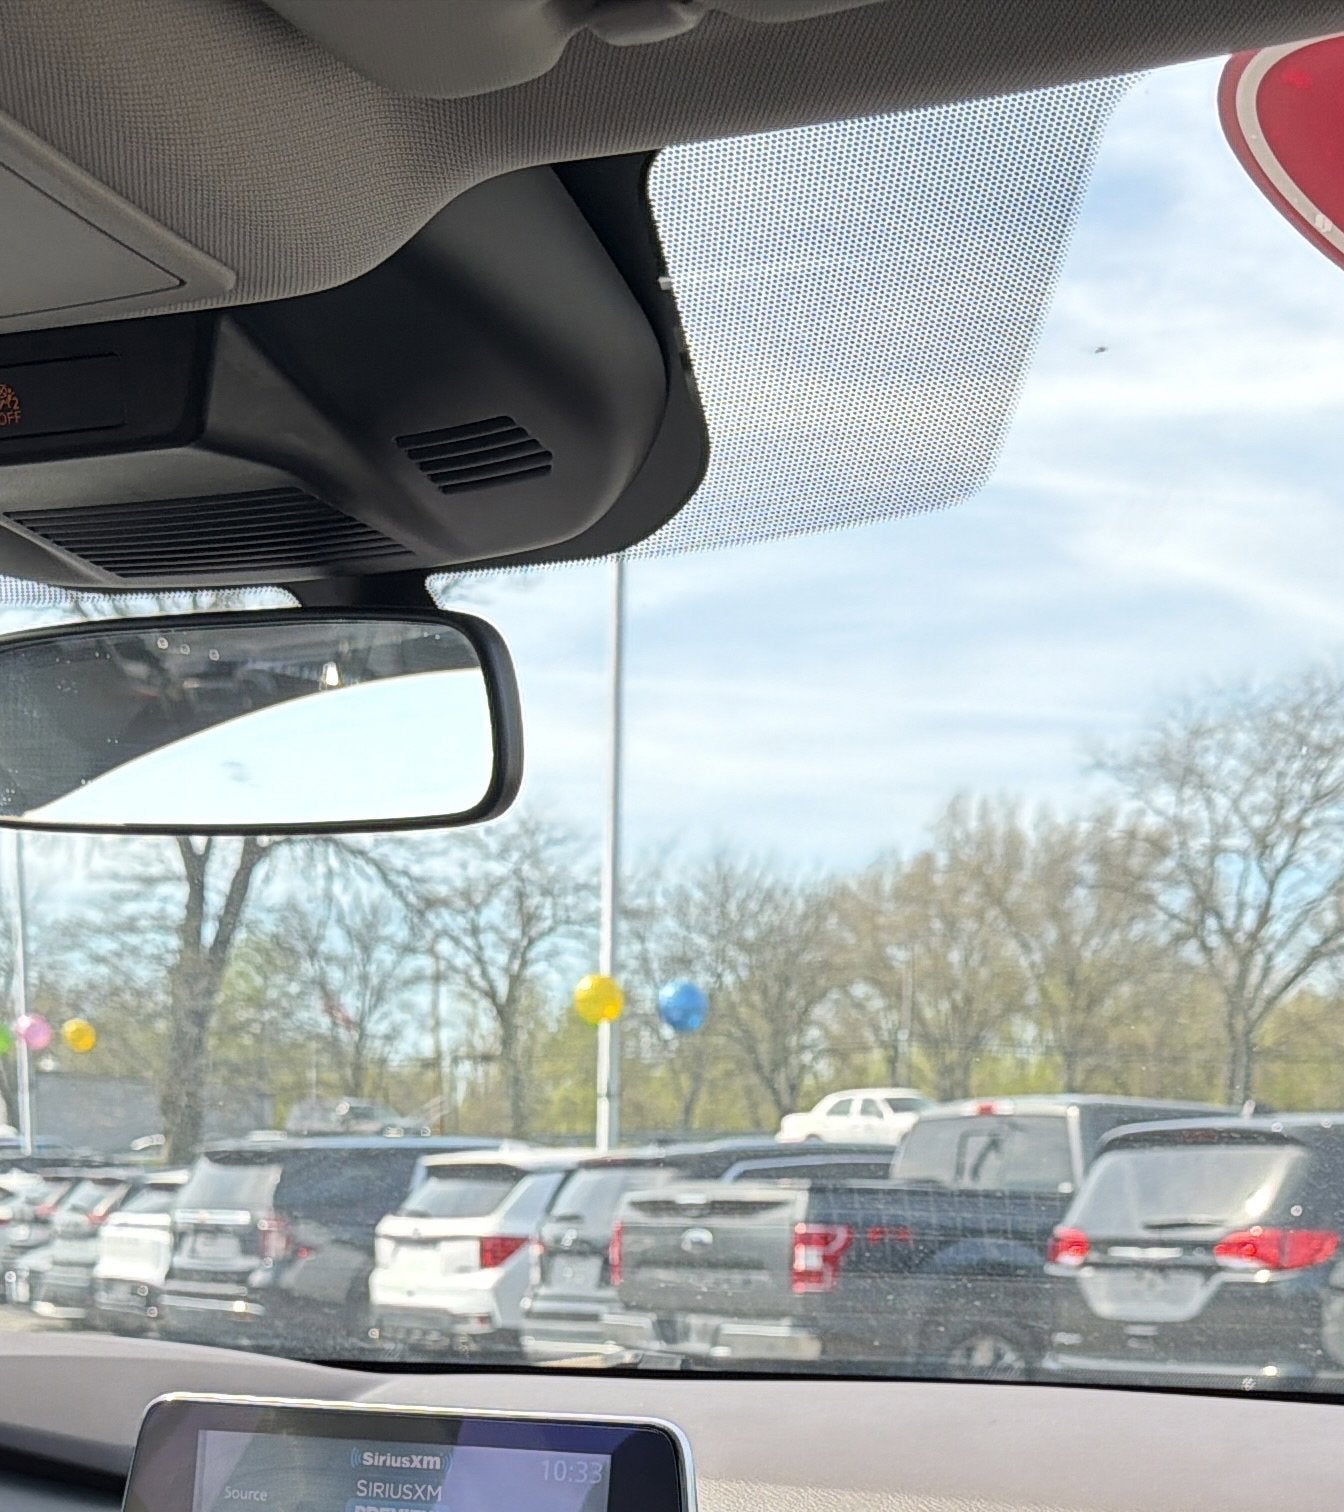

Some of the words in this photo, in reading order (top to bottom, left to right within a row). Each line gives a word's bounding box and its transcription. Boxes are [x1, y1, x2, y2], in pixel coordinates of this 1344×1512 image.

[541, 1459, 603, 1484] 10:33
[224, 1486, 268, 1502] Source
[356, 1479, 443, 1502] SIRIUSXM
